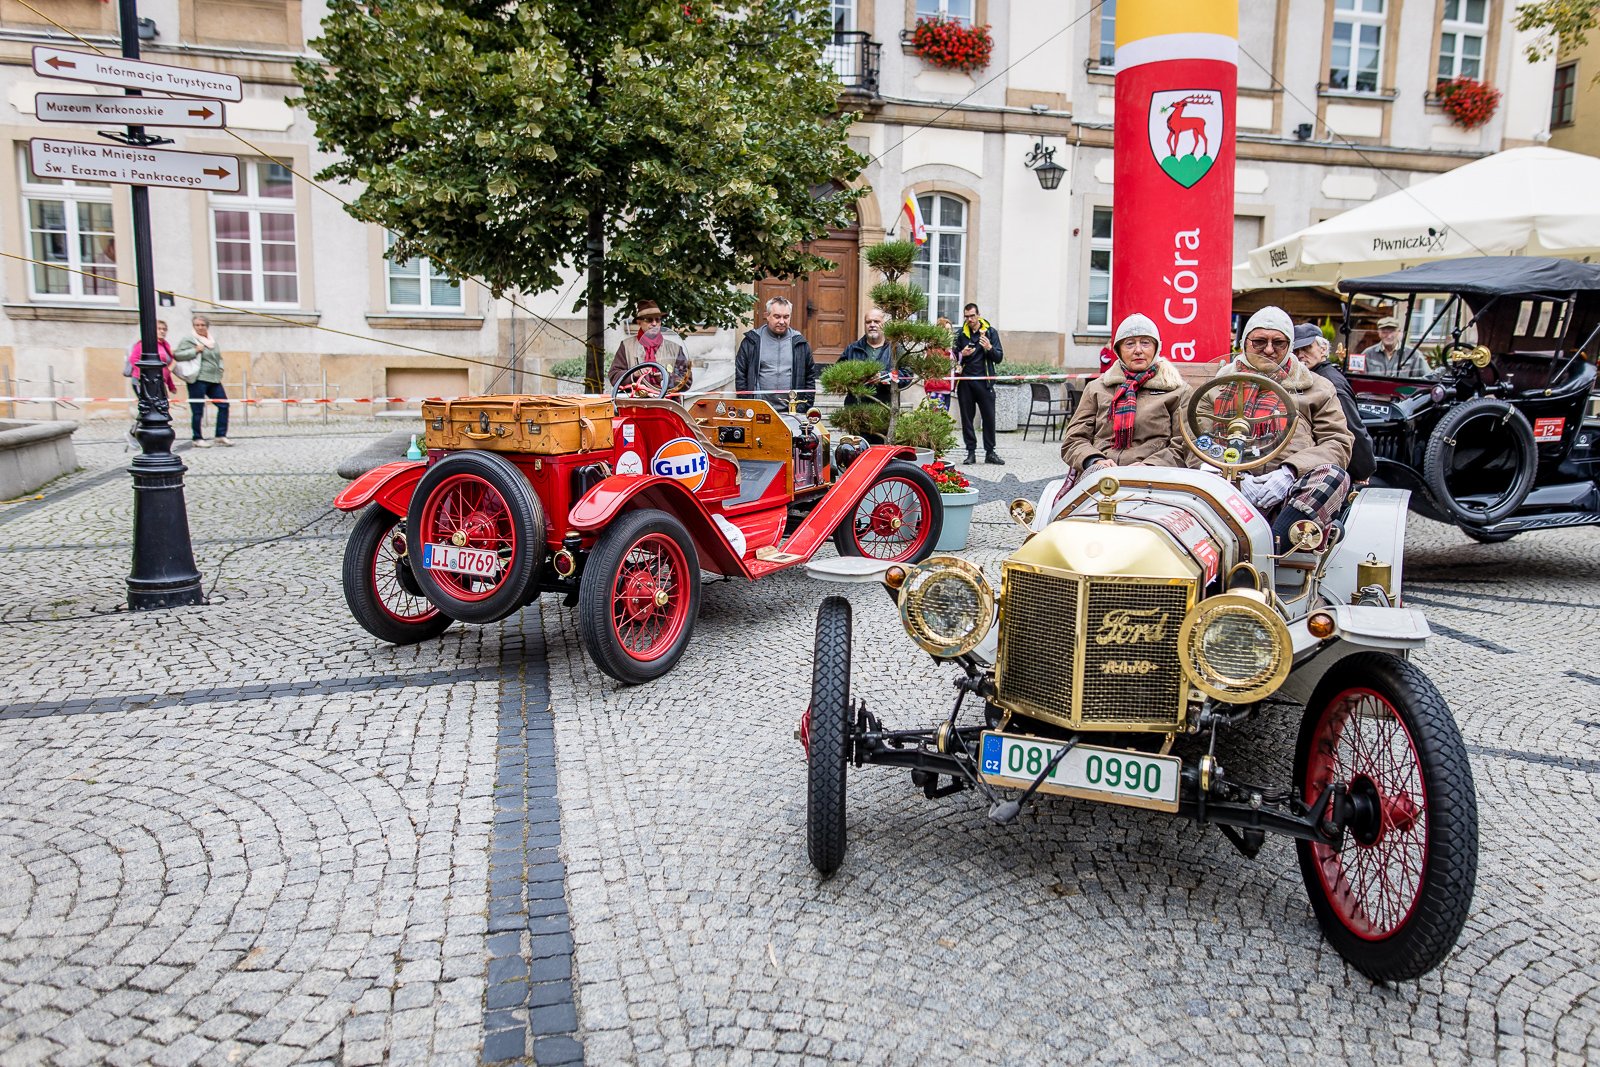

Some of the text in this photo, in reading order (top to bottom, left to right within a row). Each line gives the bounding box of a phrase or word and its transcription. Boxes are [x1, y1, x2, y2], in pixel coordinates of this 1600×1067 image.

[96, 63, 233, 92] Informacja Turystyczna
[46, 102, 164, 116] Muzeum Karkonoskie
[43, 143, 156, 163] Bazylika Mniejsza
[45, 160, 202, 186] Św. Erazma i Pankracego
[1373, 235, 1431, 251] Piwniczka
[1163, 227, 1200, 325] Góra
[1542, 424, 1555, 437] 12
[655, 456, 706, 476] Gulf
[432, 547, 494, 573] LI 0769
[1096, 607, 1170, 645] Ford
[985, 759, 999, 770] CZ
[1085, 754, 1162, 793] 0990
